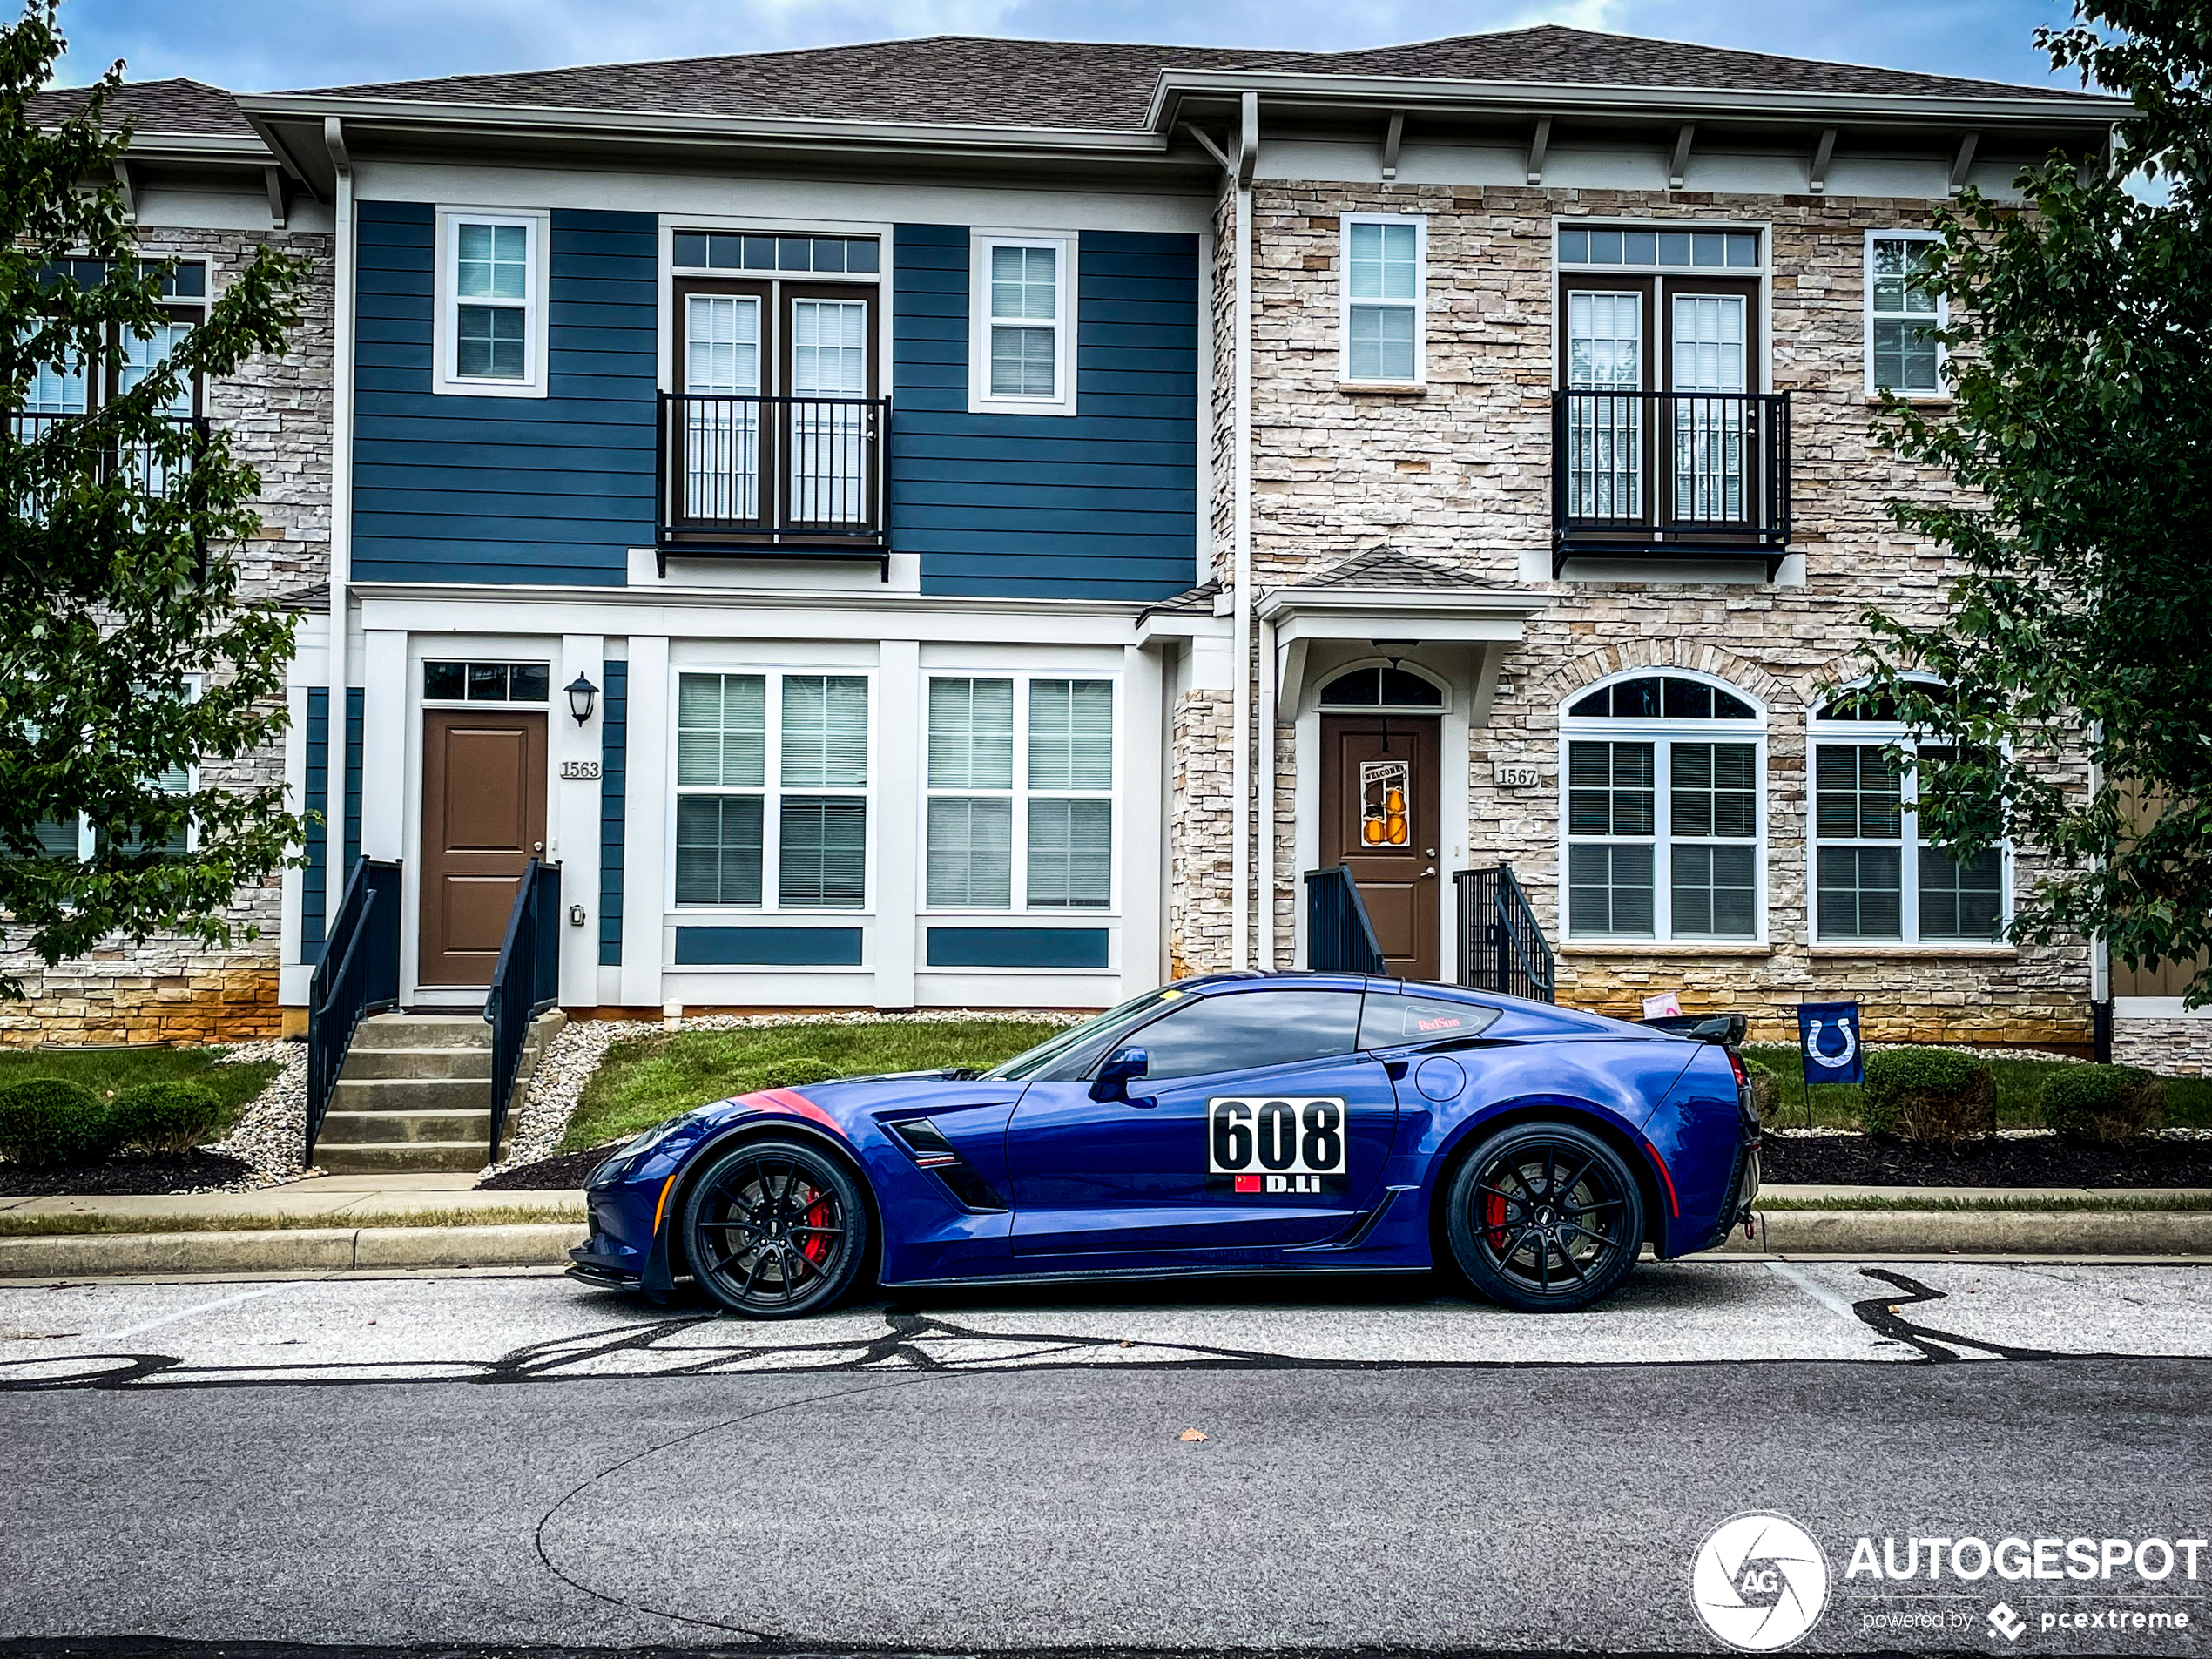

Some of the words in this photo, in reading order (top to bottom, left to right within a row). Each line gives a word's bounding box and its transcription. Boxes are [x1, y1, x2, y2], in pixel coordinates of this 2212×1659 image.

[561, 761, 599, 777] 1563
[1499, 768, 1537, 786] 1567
[1213, 1101, 1341, 1170] 608
[1266, 1175, 1321, 1193] D.Li
